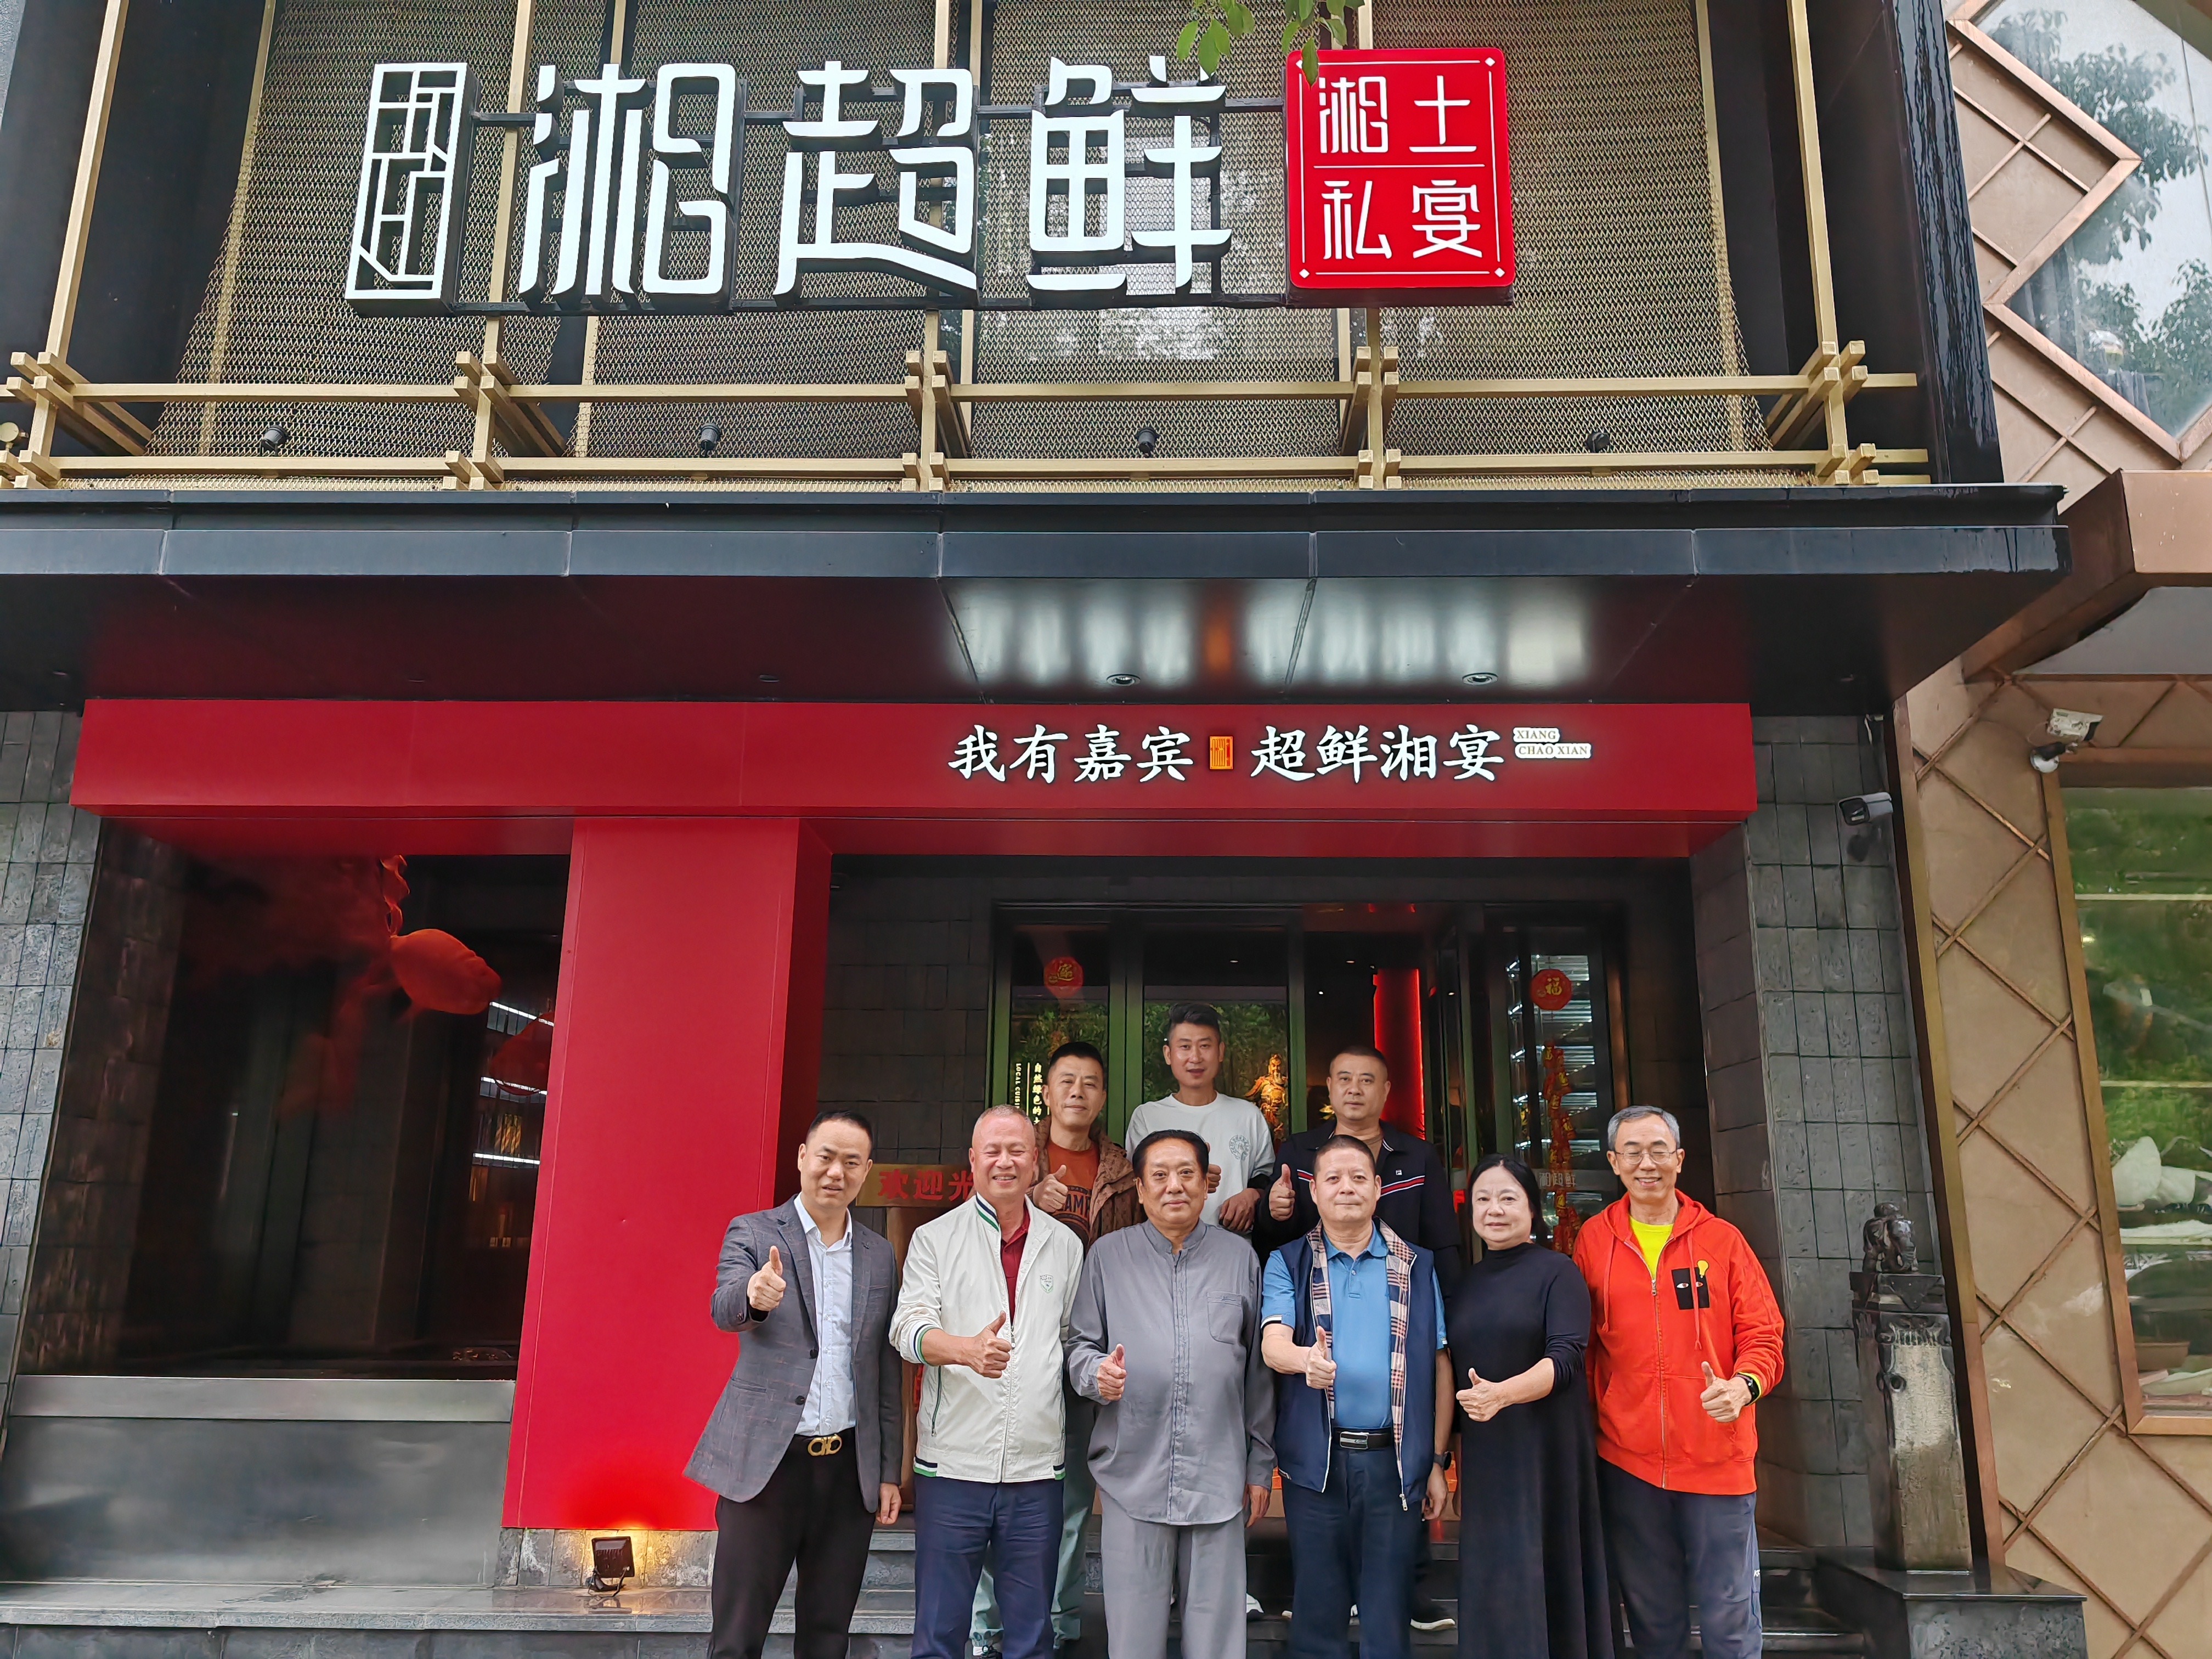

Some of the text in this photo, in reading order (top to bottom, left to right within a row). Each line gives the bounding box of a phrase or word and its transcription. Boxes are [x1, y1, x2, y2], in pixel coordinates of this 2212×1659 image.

[518, 55, 1232, 297] 湘超鲜
[1321, 179, 1483, 260] 私宴
[947, 724, 1505, 784] 我有嘉宾 超鲜湘宴
[1516, 730, 1557, 740] XIANG
[1518, 745, 1588, 755] CHAO XIAN
[878, 1169, 974, 1201] 欢迎光
